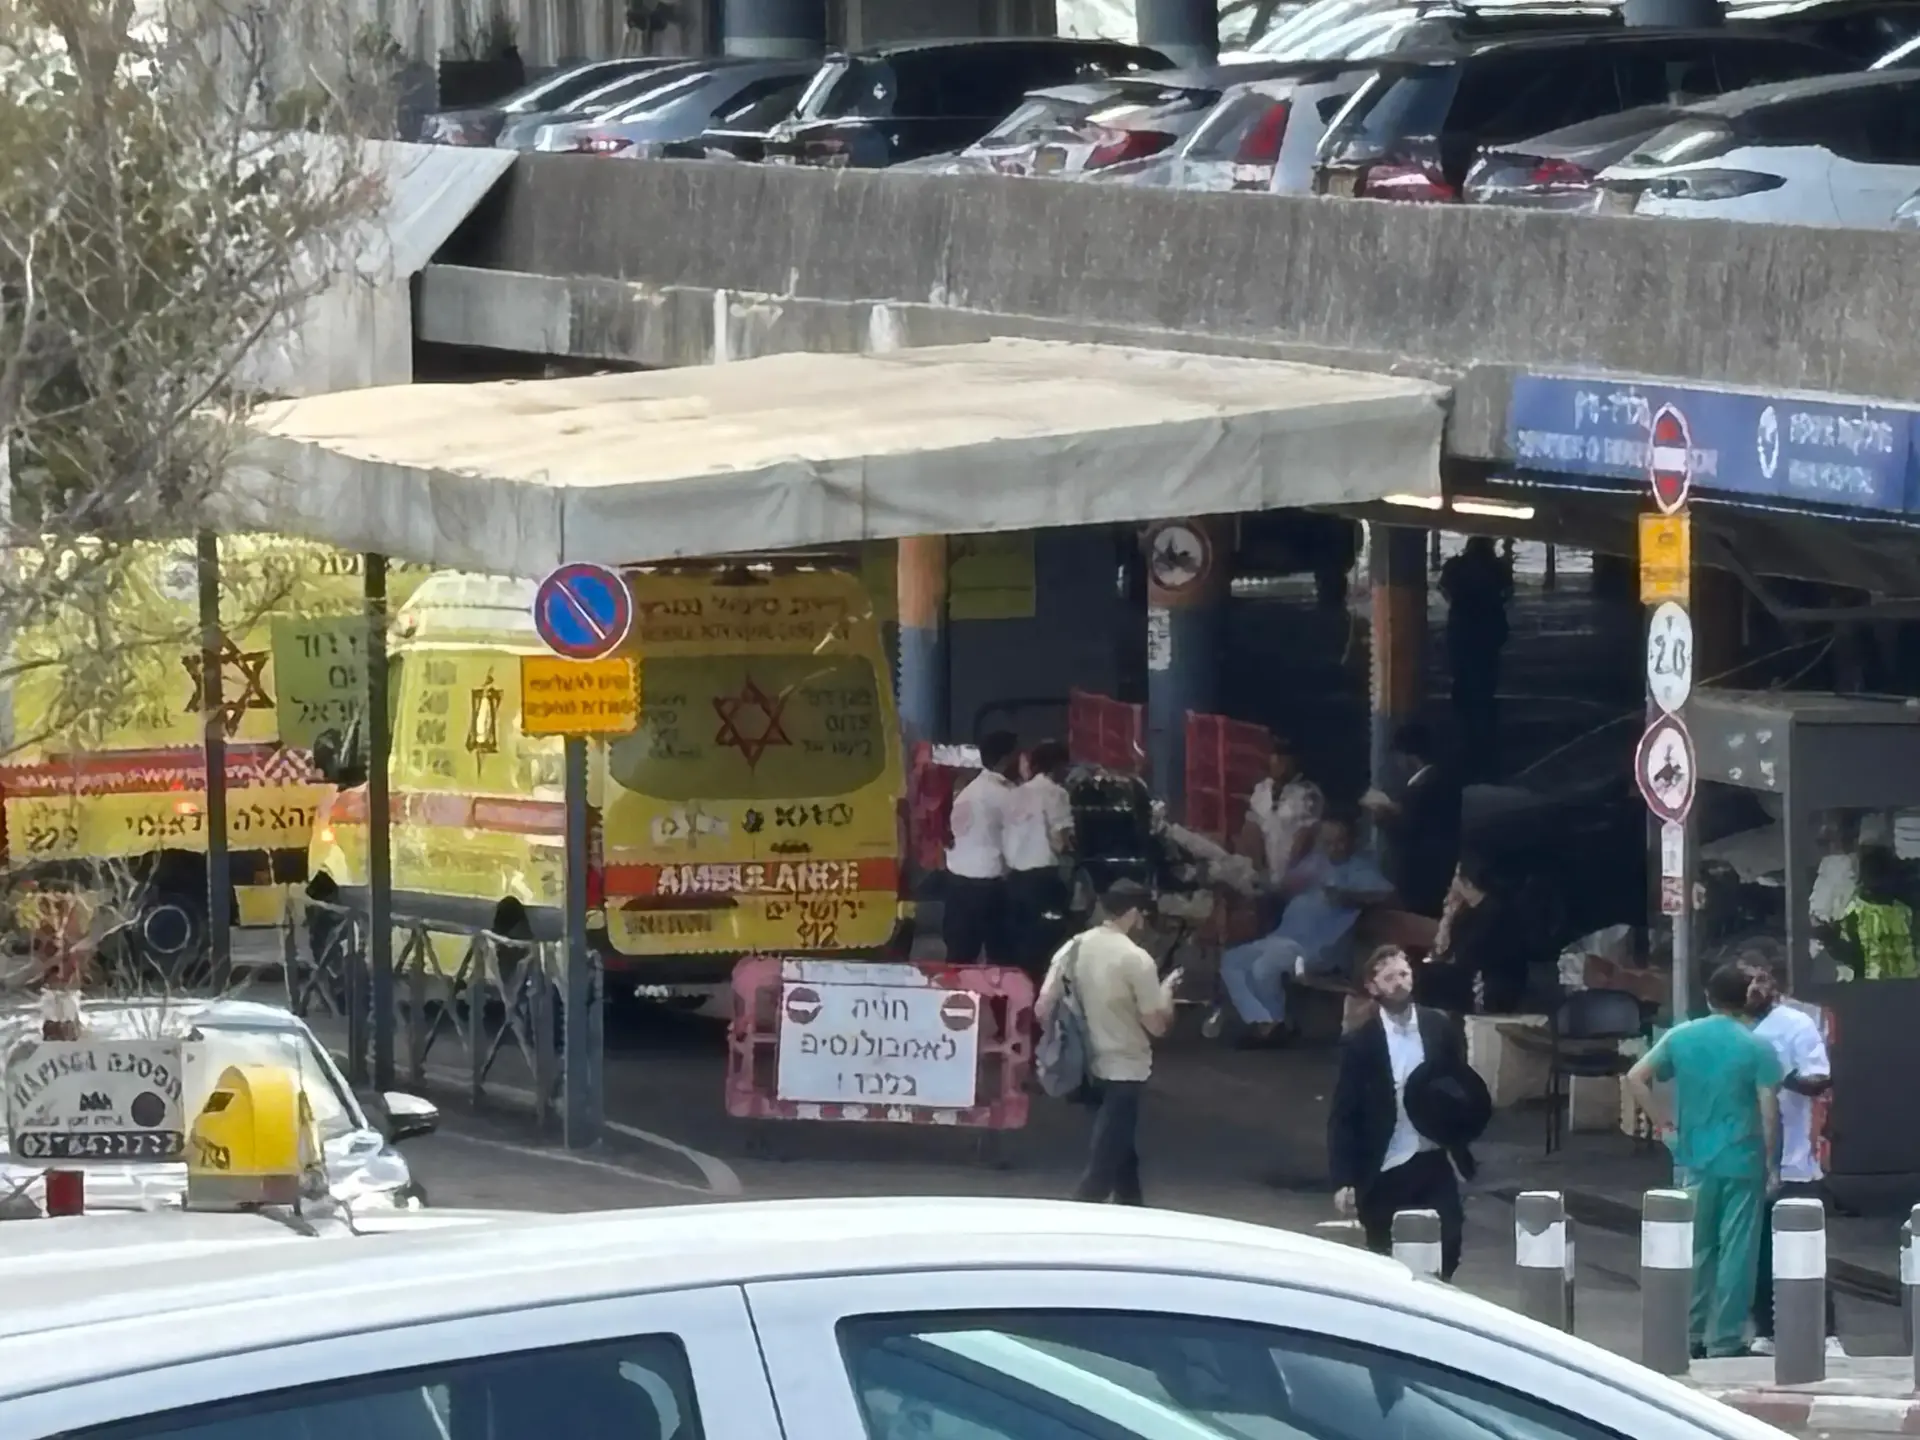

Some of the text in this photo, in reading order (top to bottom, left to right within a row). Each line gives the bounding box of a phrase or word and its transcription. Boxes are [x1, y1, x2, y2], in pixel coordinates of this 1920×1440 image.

[657, 861, 859, 895] AMBULANCE
[851, 993, 909, 1022] חניה
[800, 1030, 957, 1062] לאמבולנסים
